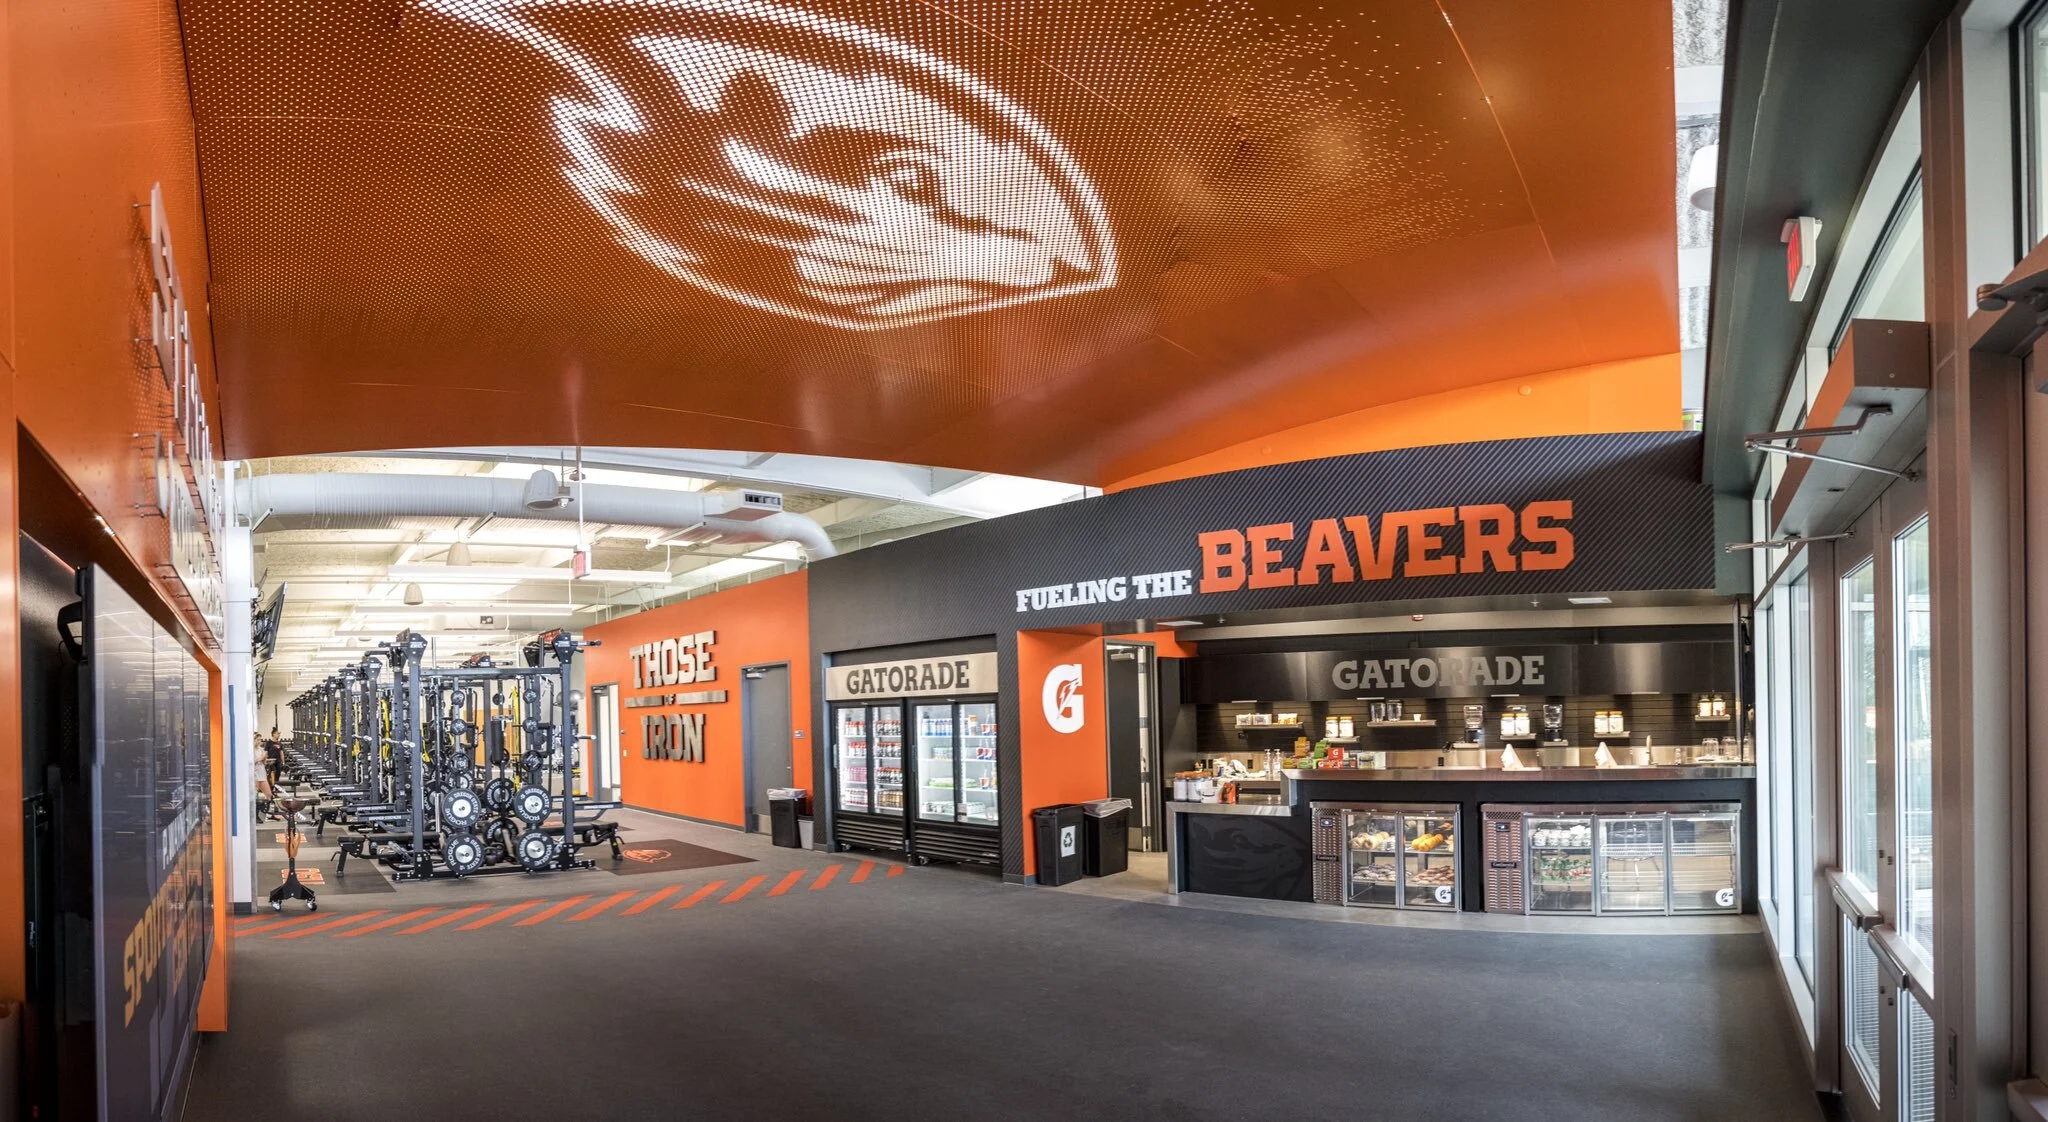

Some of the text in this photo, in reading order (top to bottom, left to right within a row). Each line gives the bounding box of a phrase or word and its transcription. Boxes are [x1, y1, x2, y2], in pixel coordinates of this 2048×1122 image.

[1016, 500, 1575, 613] FUELING THE BEAVERS
[629, 630, 717, 689] THOSE
[1331, 655, 1545, 690] GATORADE
[846, 660, 970, 695] GATORADE
[1042, 663, 1085, 734] G
[641, 713, 706, 763] IRON
[445, 807, 467, 826] ROGUE
[518, 805, 540, 821] ROGUE
[448, 839, 460, 867] ROGUE
